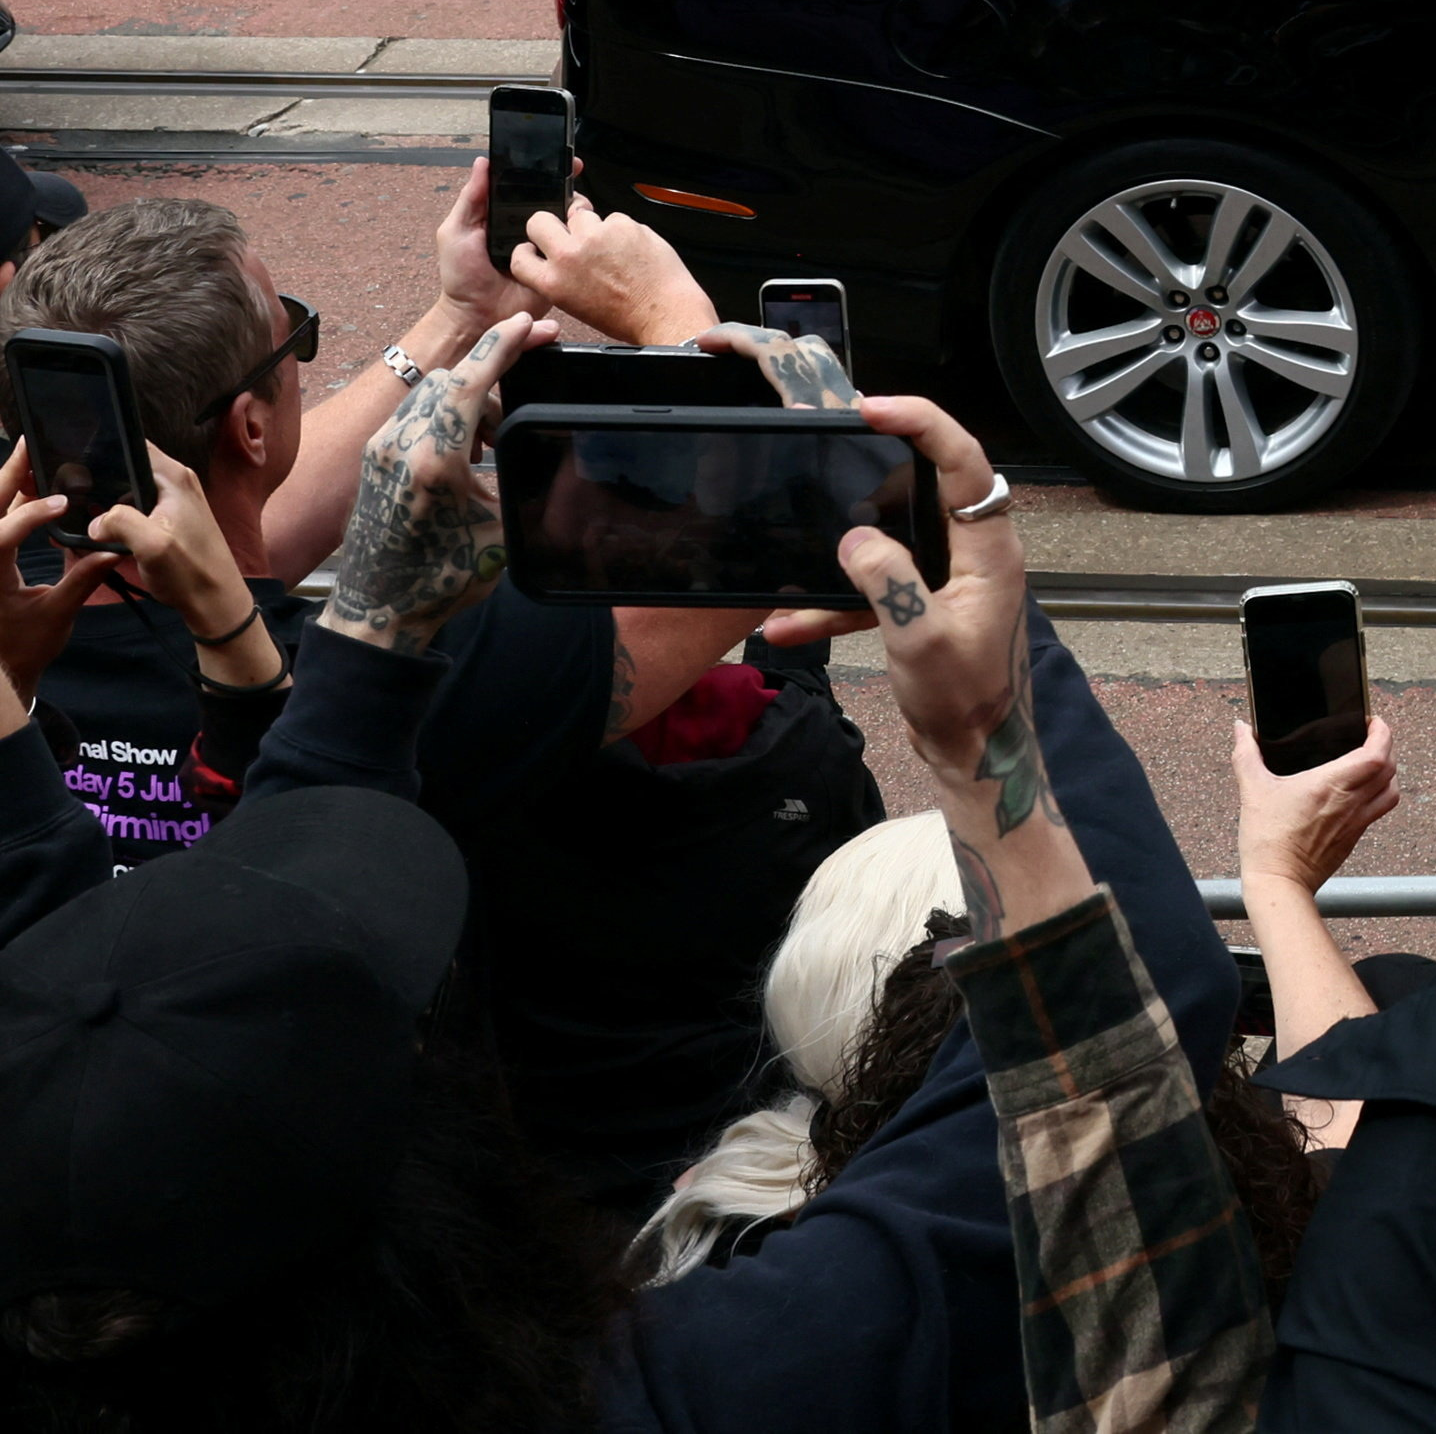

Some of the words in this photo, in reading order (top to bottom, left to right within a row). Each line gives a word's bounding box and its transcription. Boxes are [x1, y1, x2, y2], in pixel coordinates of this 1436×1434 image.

[110, 741, 177, 767] Show
[65, 768, 114, 804] day
[117, 774, 136, 799] 5
[140, 773, 193, 810] Jul
